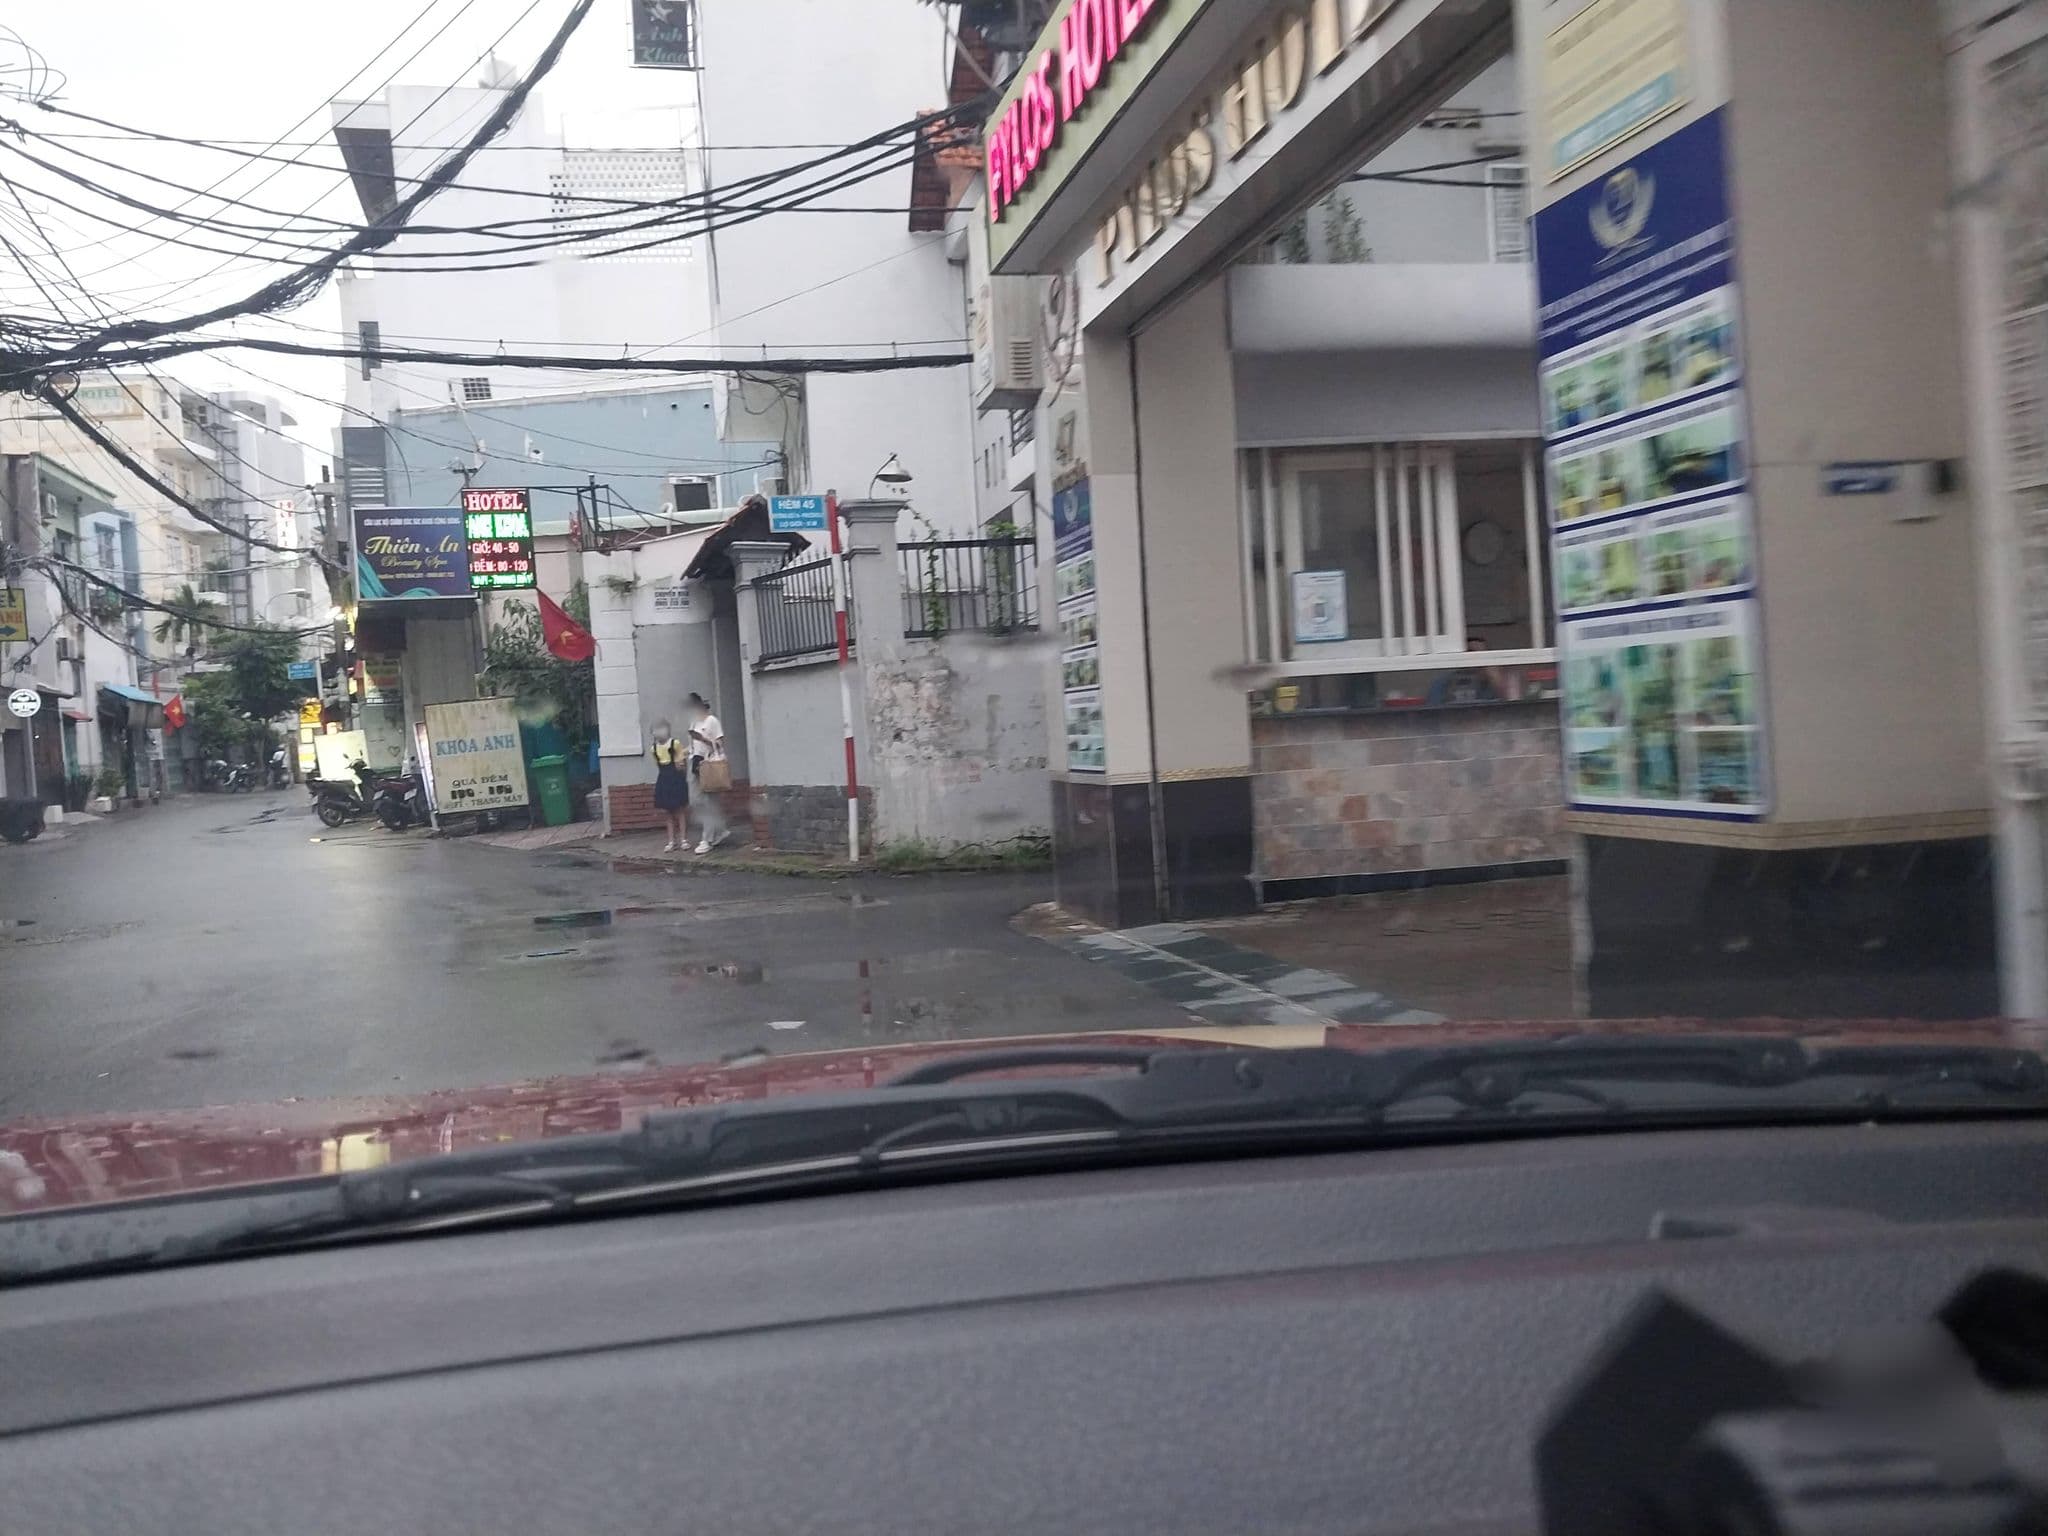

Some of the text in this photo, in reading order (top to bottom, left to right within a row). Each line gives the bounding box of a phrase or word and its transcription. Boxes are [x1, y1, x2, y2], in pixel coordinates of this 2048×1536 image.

[1060, 0, 1158, 123] HOT
[467, 493, 523, 511] HOTEL
[364, 534, 459, 555] Thiên An
[435, 733, 516, 756] KHOA ANH
